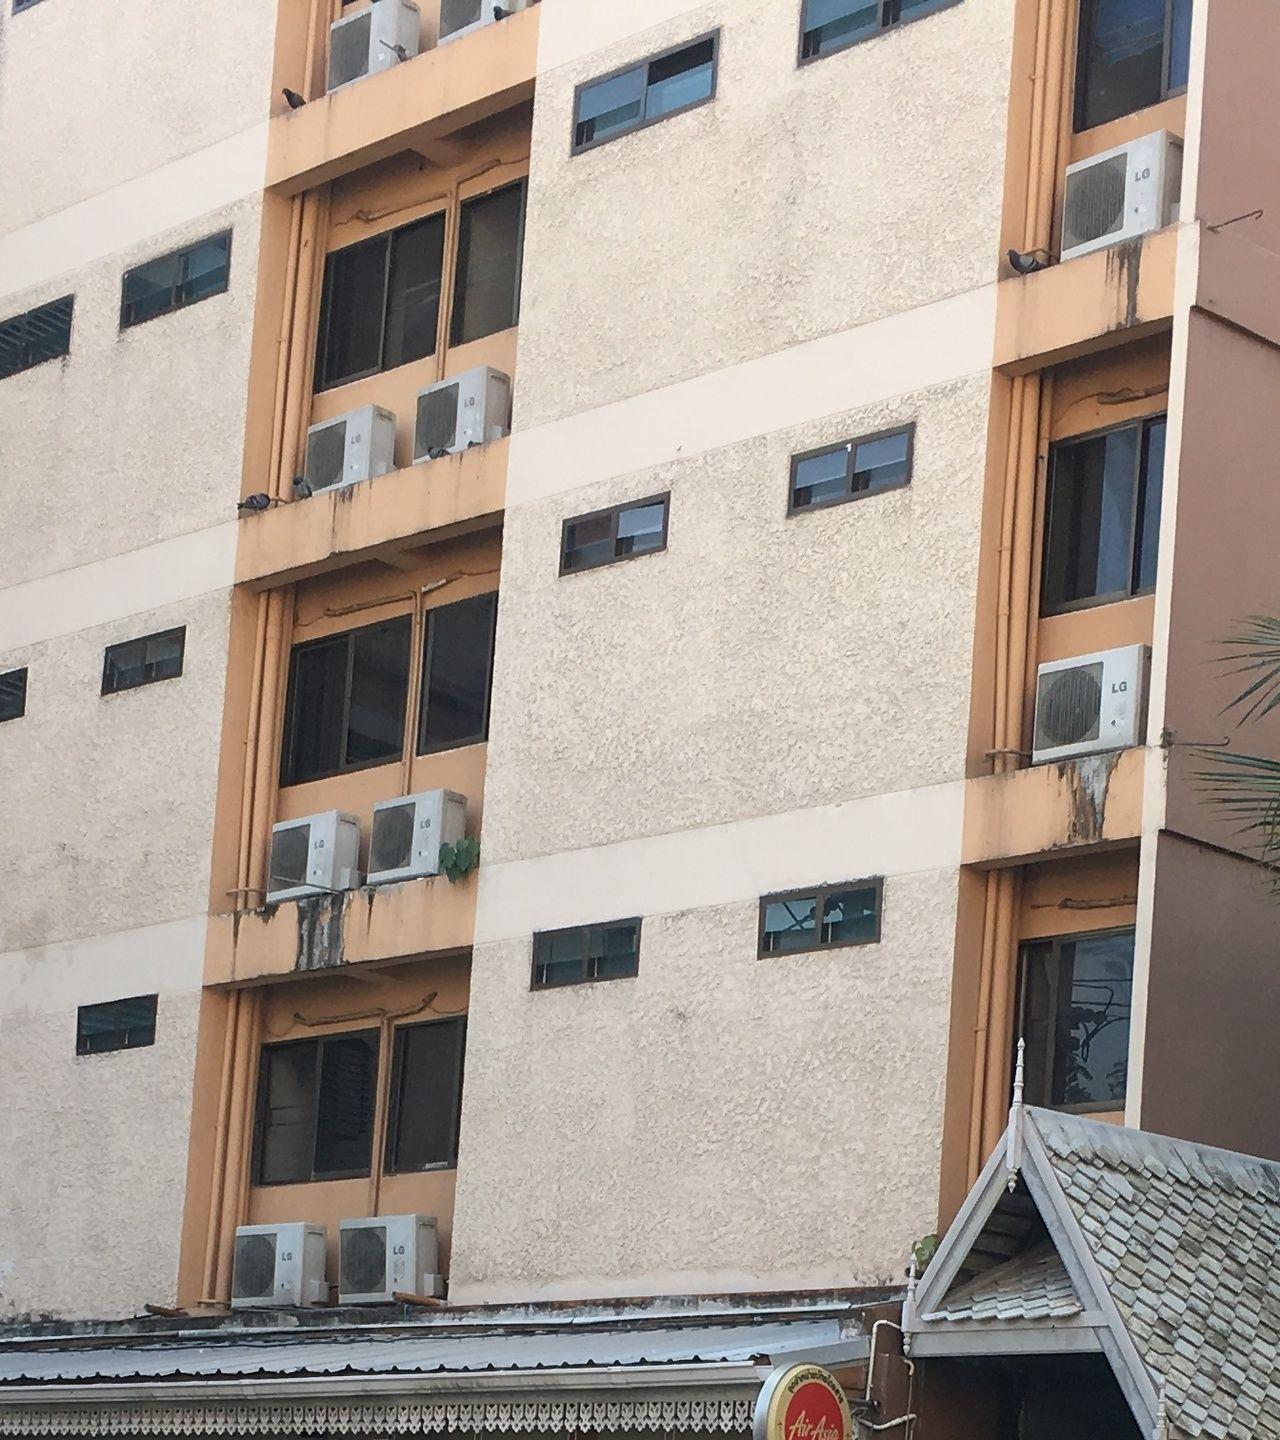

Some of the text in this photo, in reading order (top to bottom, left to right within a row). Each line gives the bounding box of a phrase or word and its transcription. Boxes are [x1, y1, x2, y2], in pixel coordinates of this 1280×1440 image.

[1135, 168, 1150, 182] LG
[1112, 681, 1127, 694] LG
[420, 818, 431, 830] LG
[393, 1245, 405, 1255] LG
[282, 1252, 292, 1262] LG
